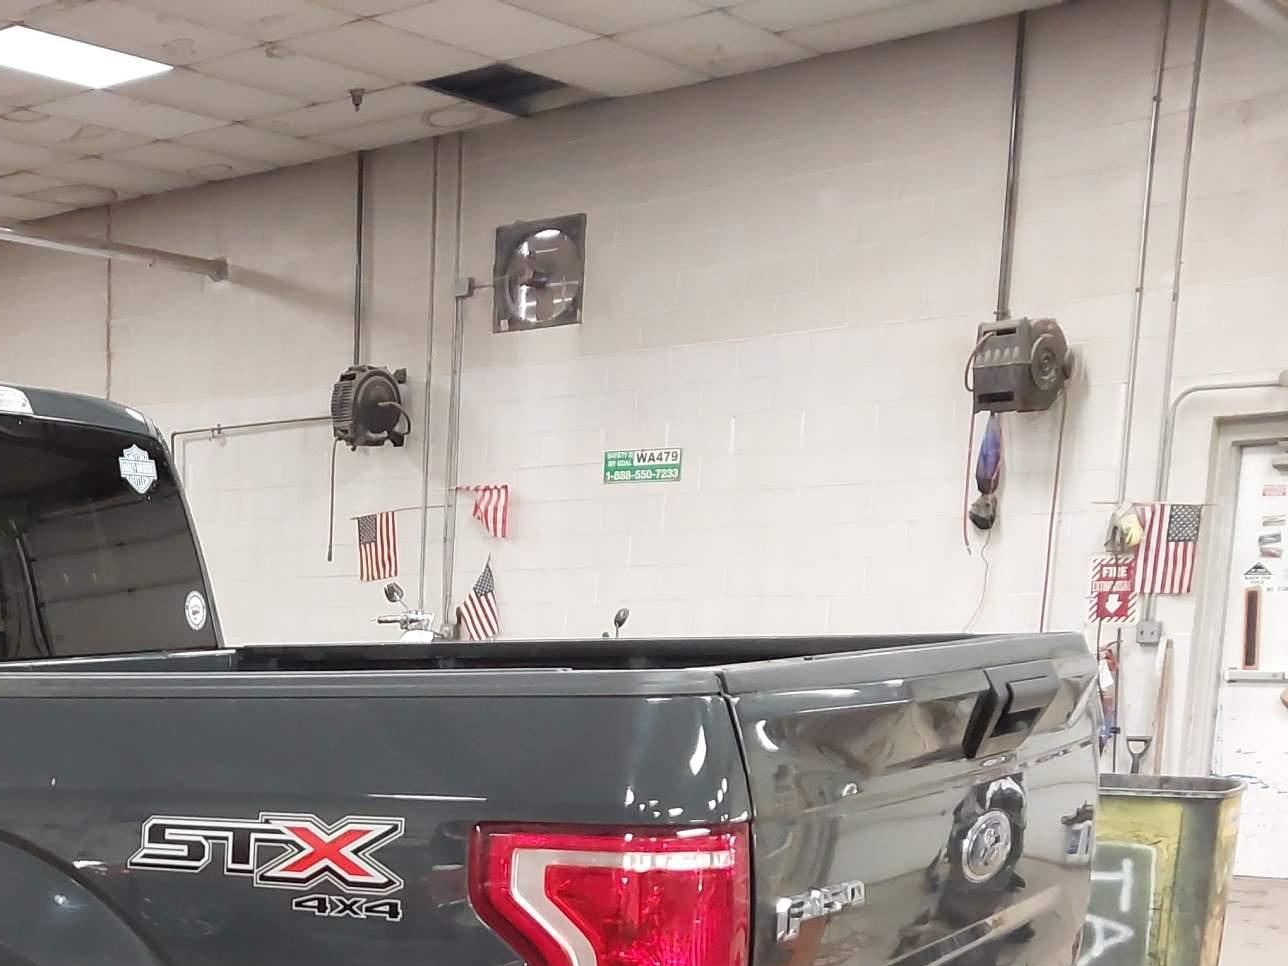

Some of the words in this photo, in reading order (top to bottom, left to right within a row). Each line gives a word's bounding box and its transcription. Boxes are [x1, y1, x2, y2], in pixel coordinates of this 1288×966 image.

[636, 450, 678, 464] WA479
[606, 468, 679, 480] 1-888-550-7233
[127, 812, 406, 895] STX
